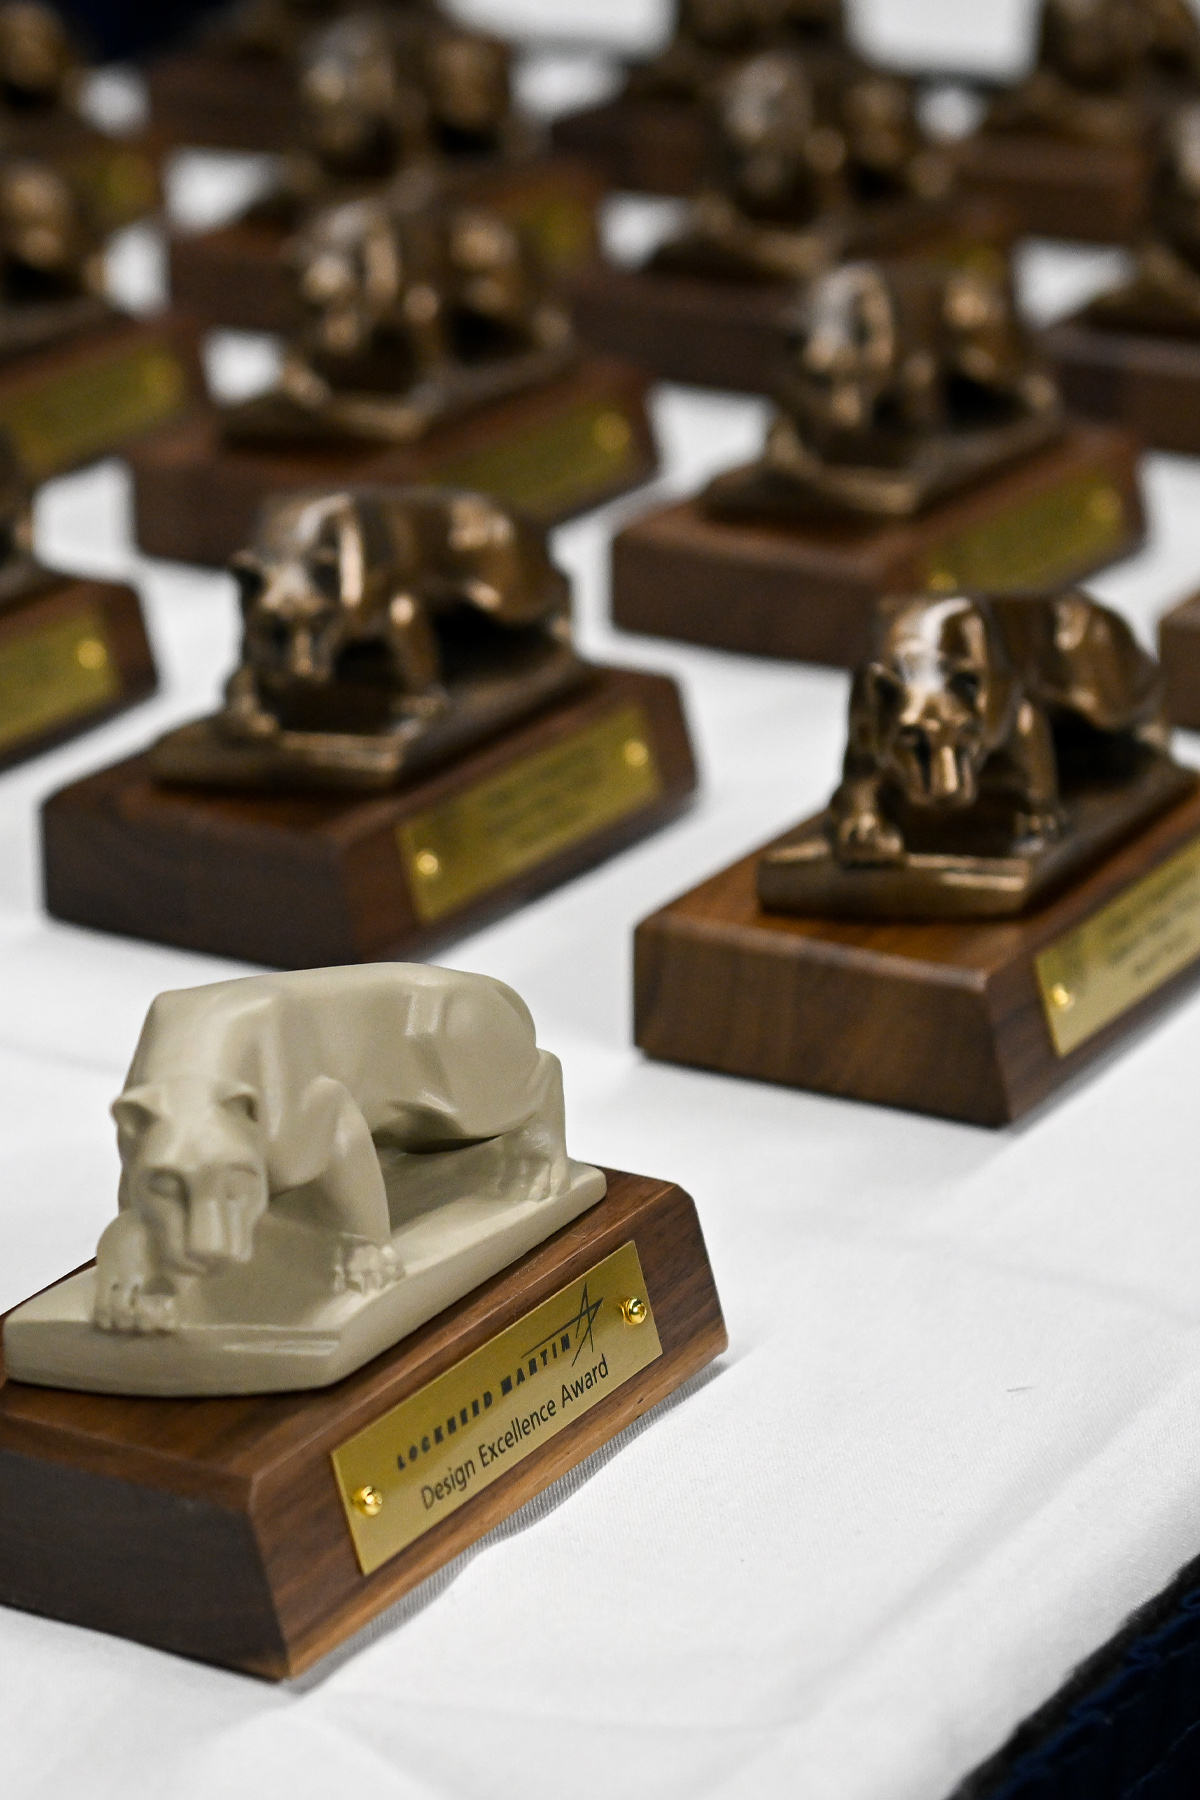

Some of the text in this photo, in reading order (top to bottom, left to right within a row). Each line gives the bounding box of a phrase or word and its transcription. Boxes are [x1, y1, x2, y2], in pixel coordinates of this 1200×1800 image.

[397, 1333, 571, 1471] LOCKHEED MARTIN
[420, 1353, 609, 1510] Design Excellence Award
